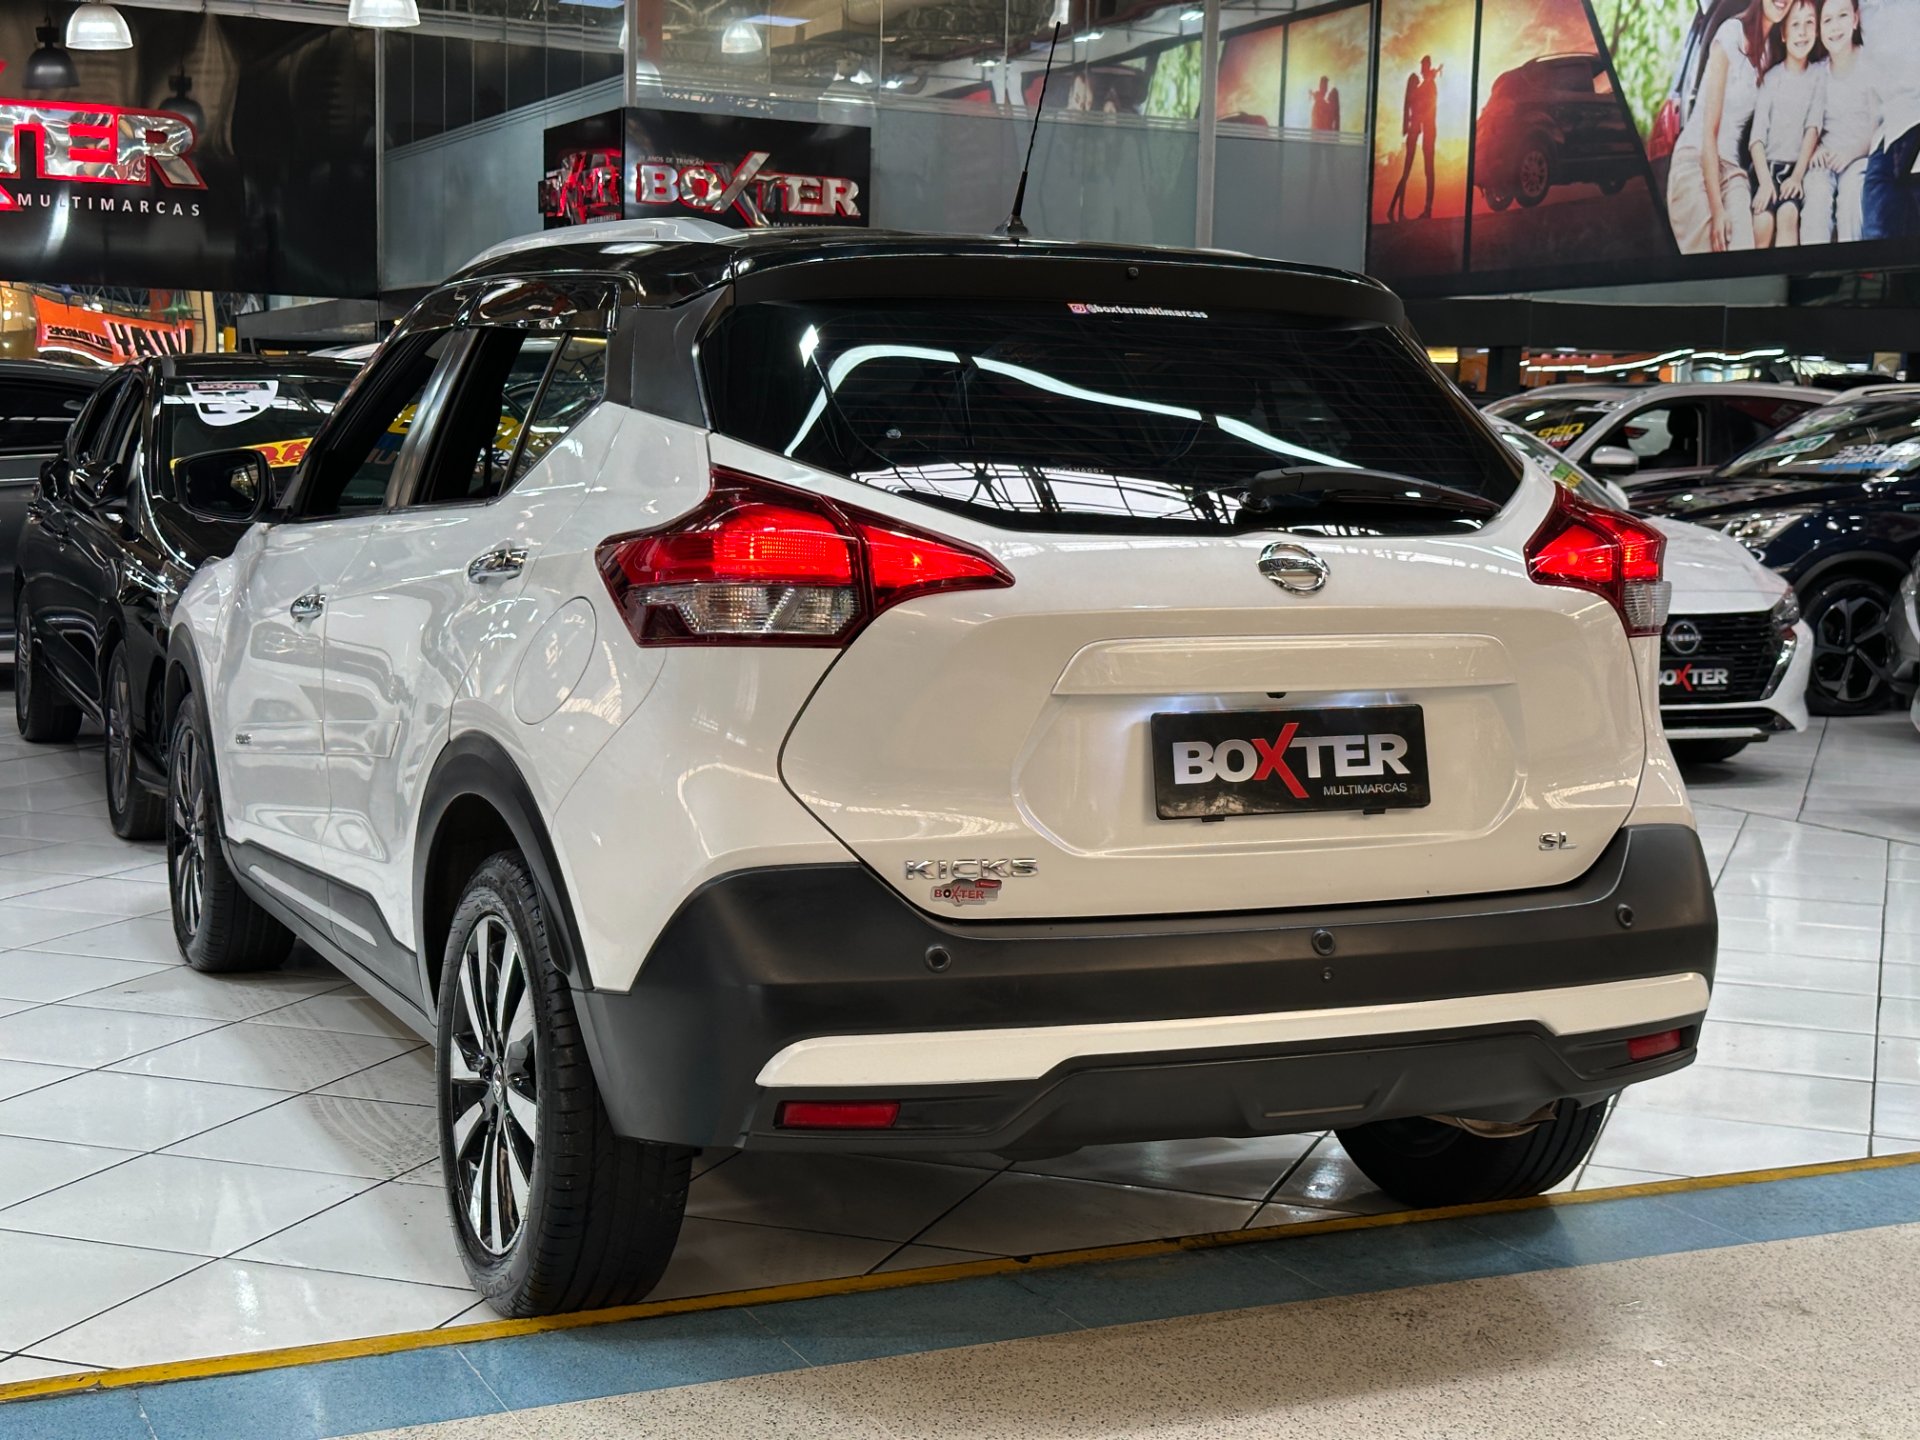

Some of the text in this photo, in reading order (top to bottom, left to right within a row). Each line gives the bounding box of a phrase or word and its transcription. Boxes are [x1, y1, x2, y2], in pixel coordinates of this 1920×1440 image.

[635, 151, 861, 228] BOXTER
[17, 192, 201, 217] MULTIMARCAS
[1086, 303, 1209, 319] @boxtermultimarcas
[1172, 722, 1411, 799] BOXTER
[1322, 782, 1408, 796] MULTIMARCAS
[1538, 831, 1577, 851] SL
[904, 858, 1039, 881] KICKS
[933, 885, 985, 903] BOXTER
